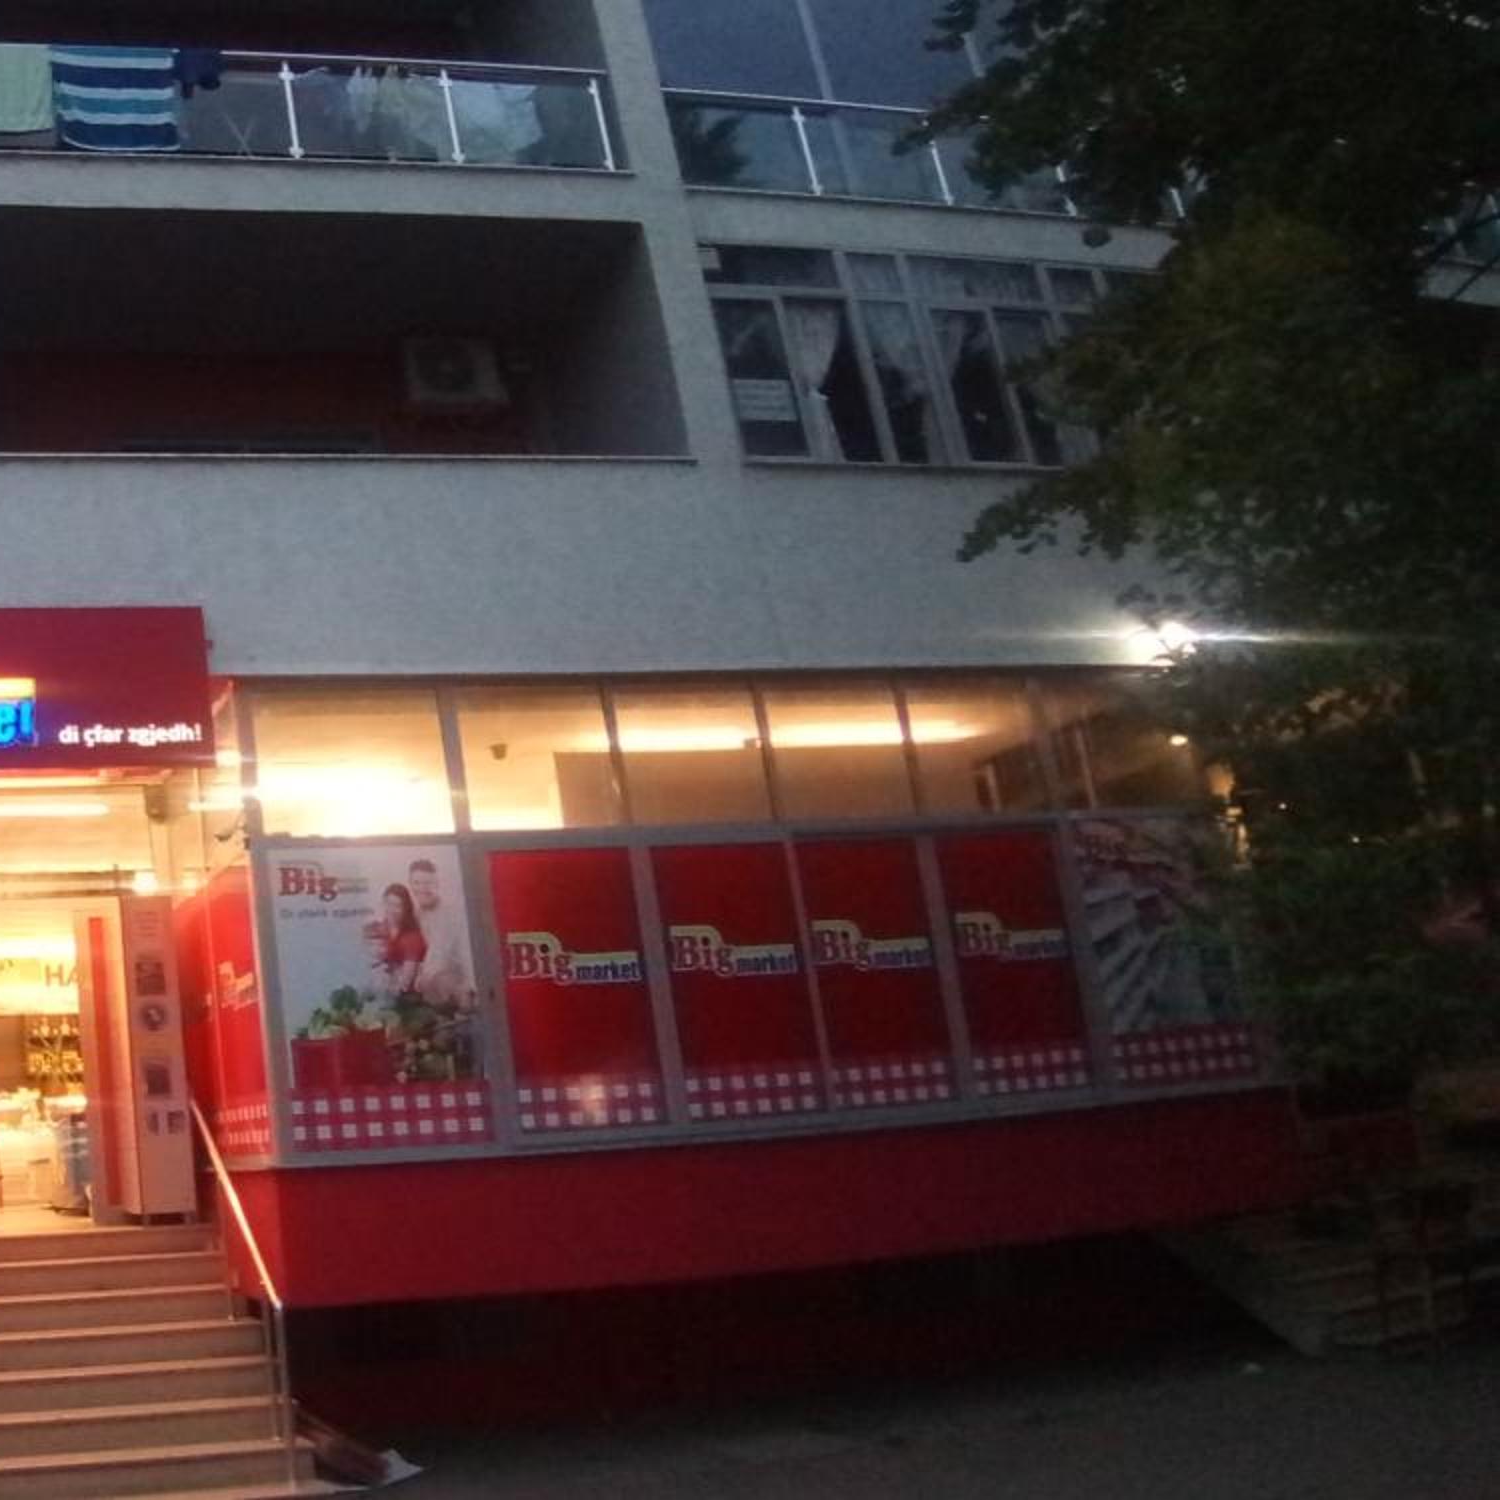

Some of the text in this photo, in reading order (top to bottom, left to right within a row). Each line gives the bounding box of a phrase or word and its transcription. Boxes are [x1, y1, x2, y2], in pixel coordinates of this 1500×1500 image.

[58, 724, 78, 744] di
[277, 867, 338, 902] Big
[672, 935, 798, 977] Big market
[812, 929, 869, 971] Big
[957, 922, 1012, 963] Big
[508, 943, 641, 985] Big market
